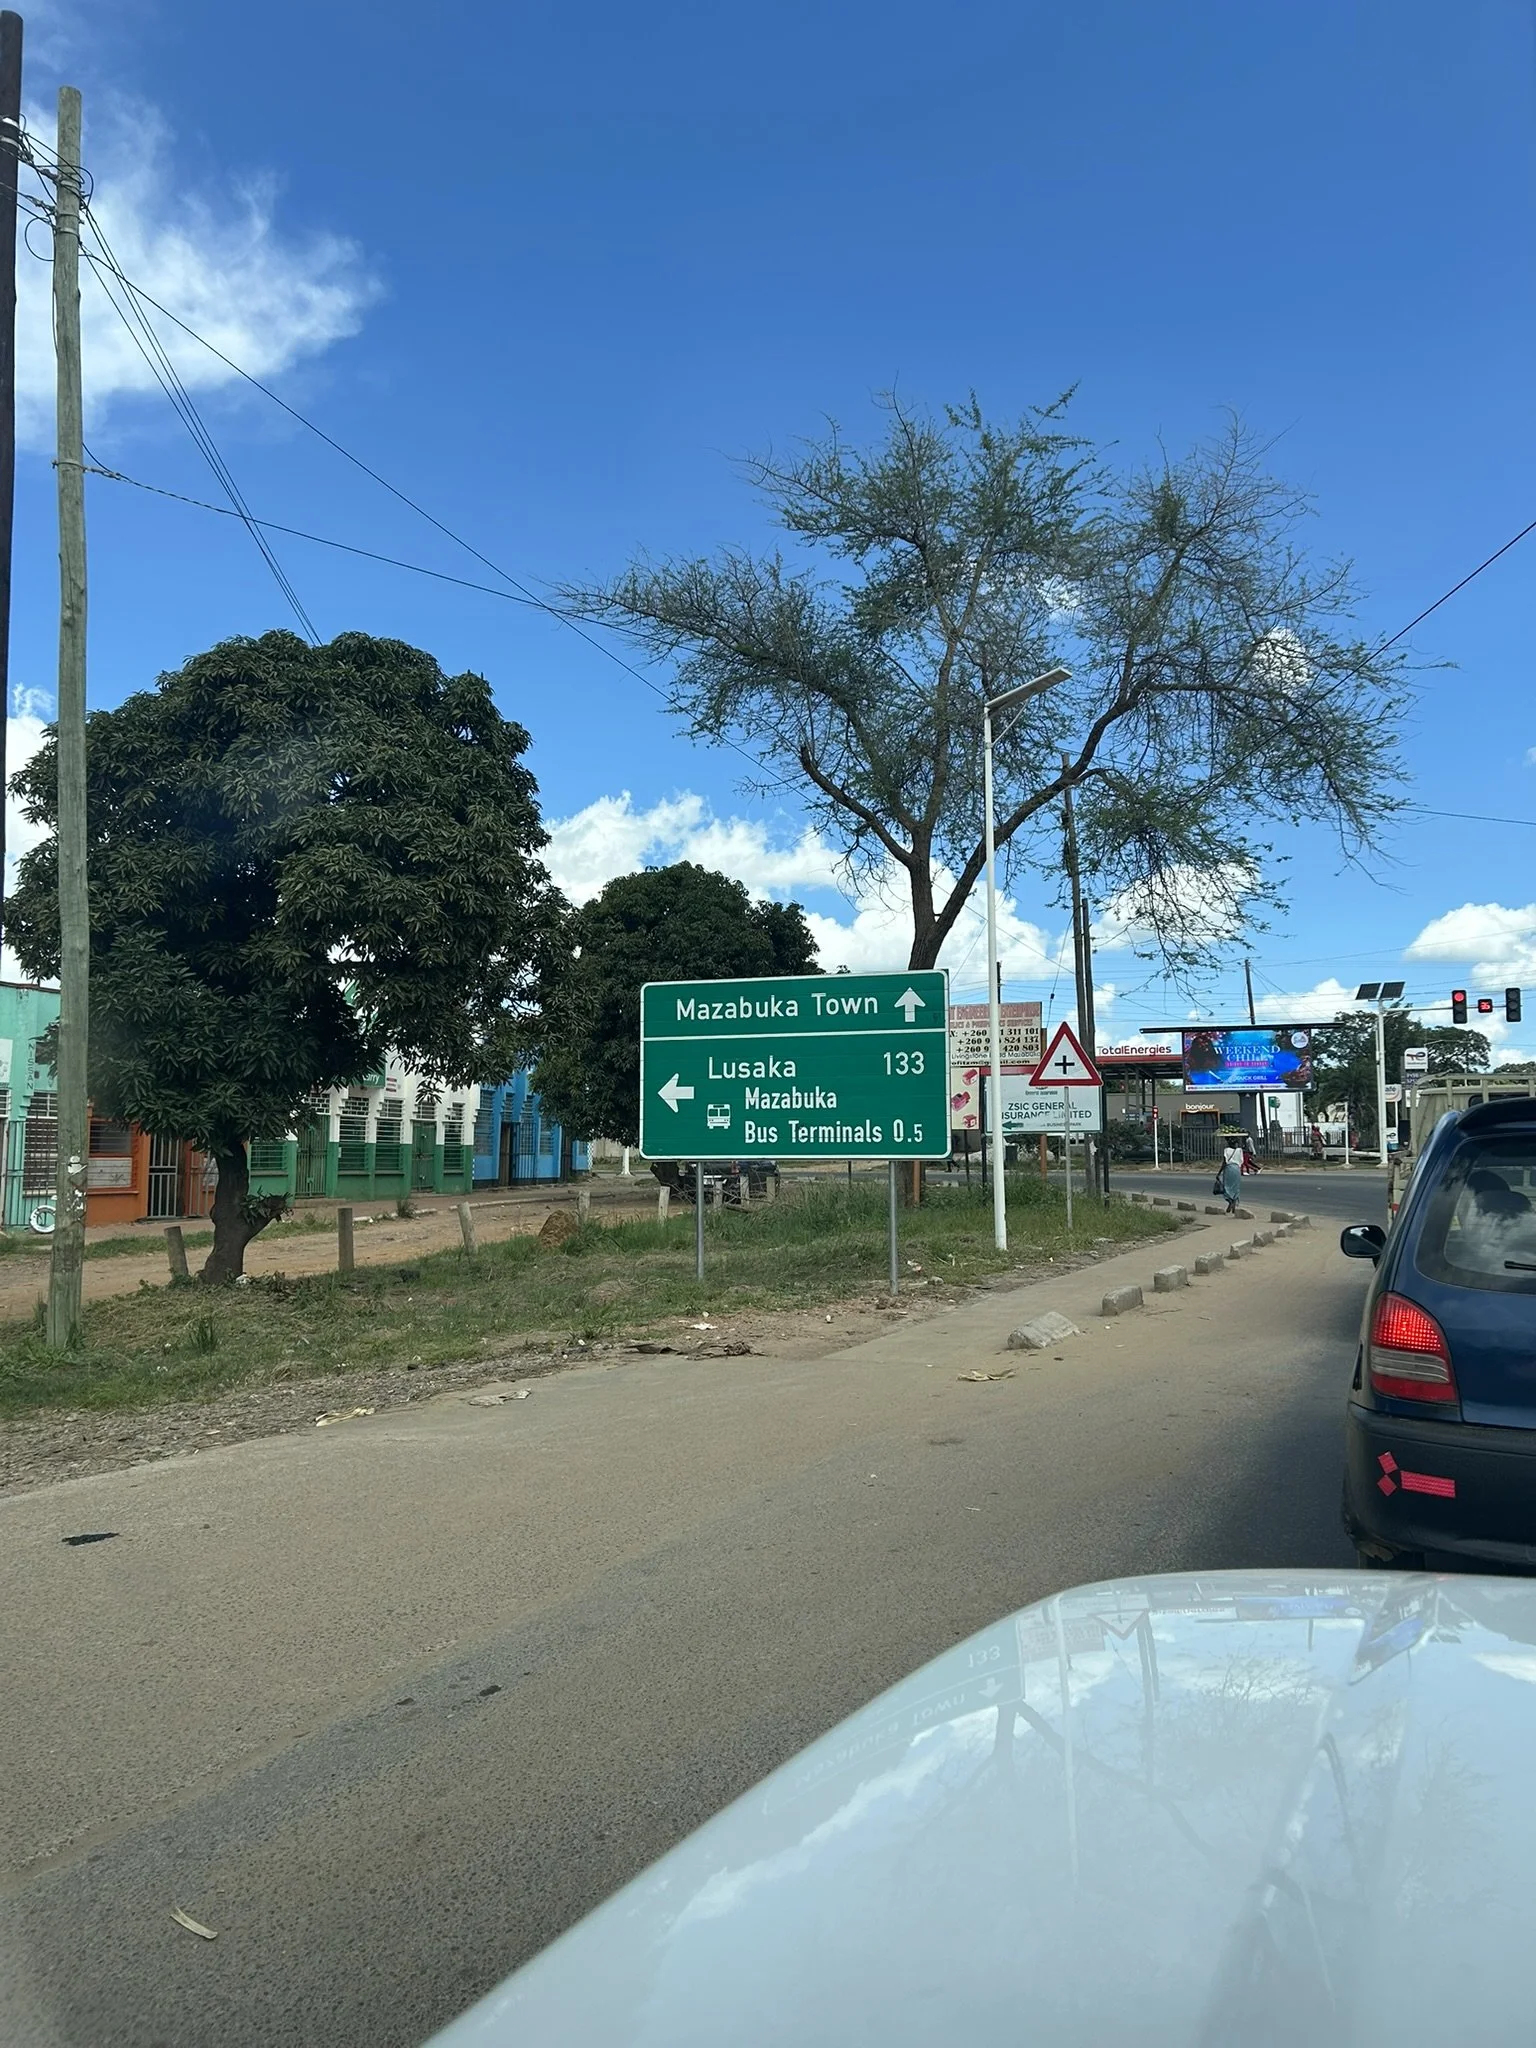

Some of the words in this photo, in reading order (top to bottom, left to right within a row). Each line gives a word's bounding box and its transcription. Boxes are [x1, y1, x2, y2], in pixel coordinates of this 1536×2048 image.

[676, 994, 799, 1021] Mazabuka
[811, 992, 878, 1016] Town
[1096, 1045, 1172, 1056] TotalEnergies
[1213, 1045, 1281, 1055] WEEKEND
[27, 1043, 35, 1090] NISSAN
[708, 1055, 796, 1080] Lusaka
[883, 1051, 925, 1076] 133
[744, 1086, 837, 1110] Mazabuka
[1008, 1102, 1029, 1111] ZSIC
[1185, 1103, 1215, 1112] bonjour
[744, 1120, 778, 1144] Bus
[788, 1119, 883, 1144] Terminals
[893, 1118, 923, 1143] 0.5
